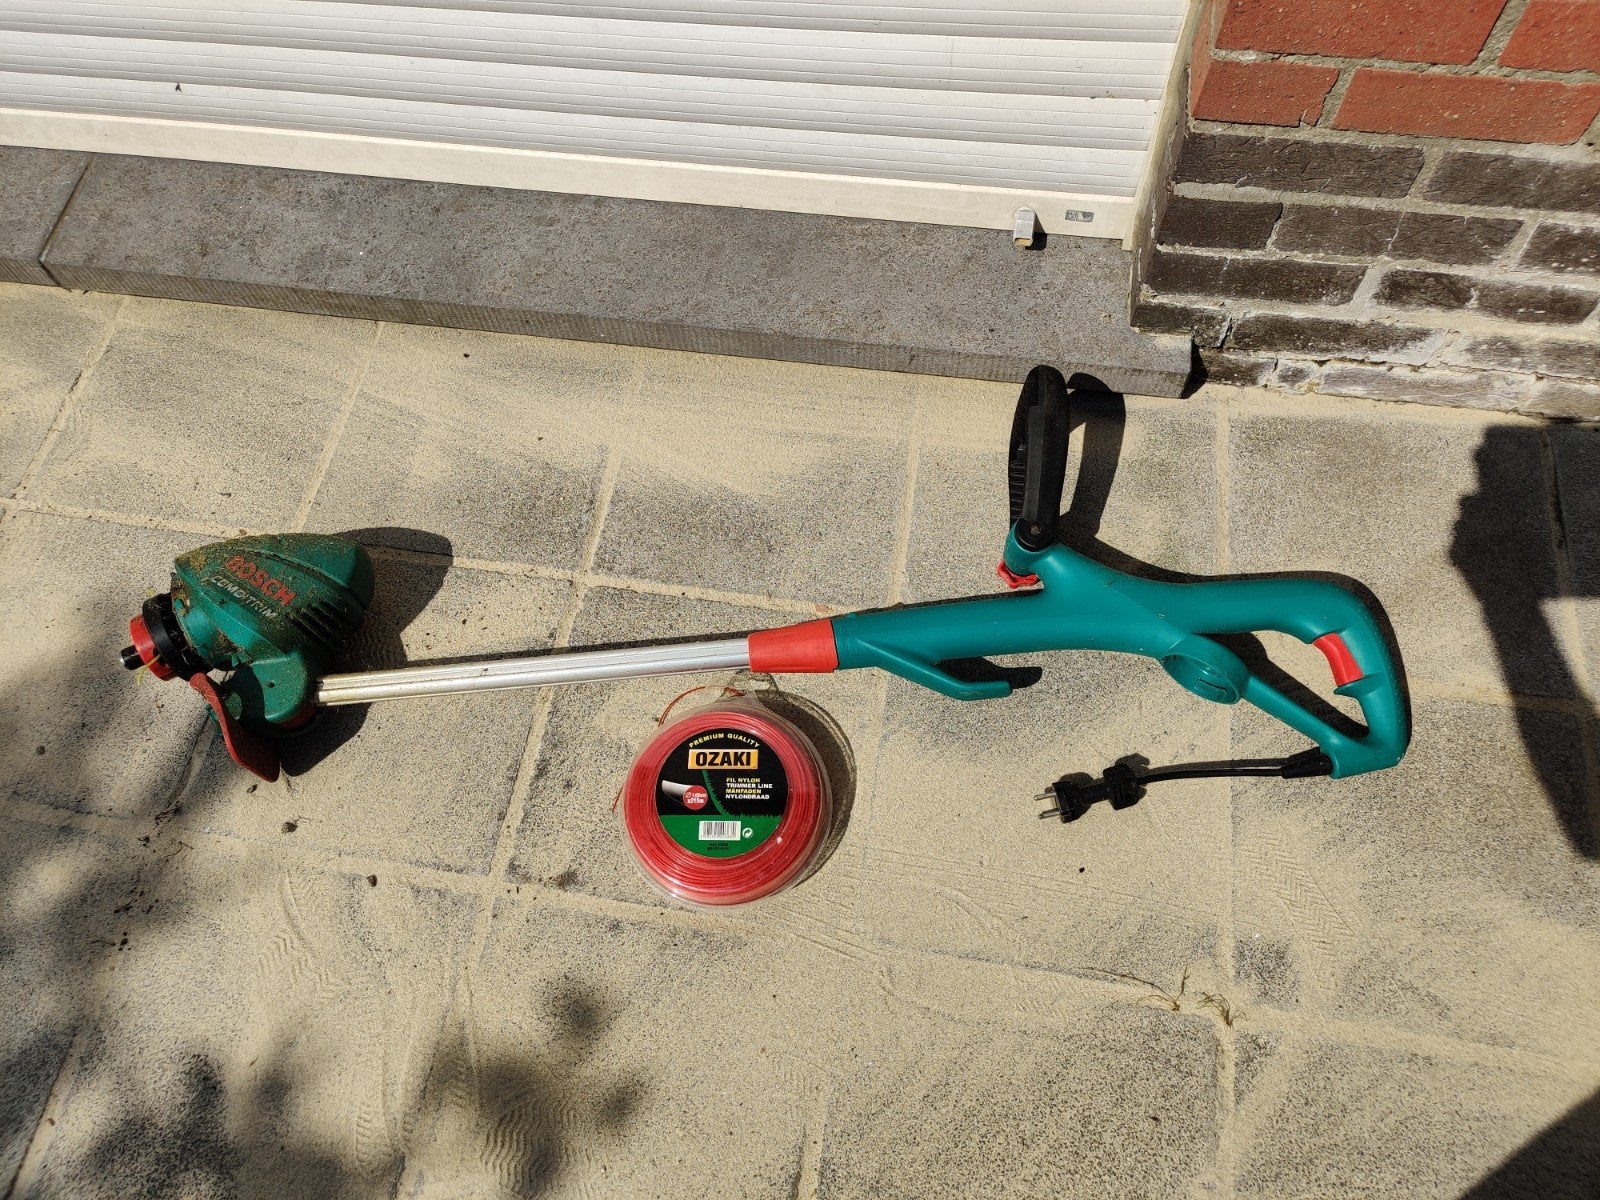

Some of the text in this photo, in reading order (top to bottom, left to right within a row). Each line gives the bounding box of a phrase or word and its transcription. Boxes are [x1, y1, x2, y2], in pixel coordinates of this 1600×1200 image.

[226, 555, 297, 607] BOSCH
[688, 732, 760, 748] PREMIUM QUALITY
[695, 751, 752, 767] OZAKI
